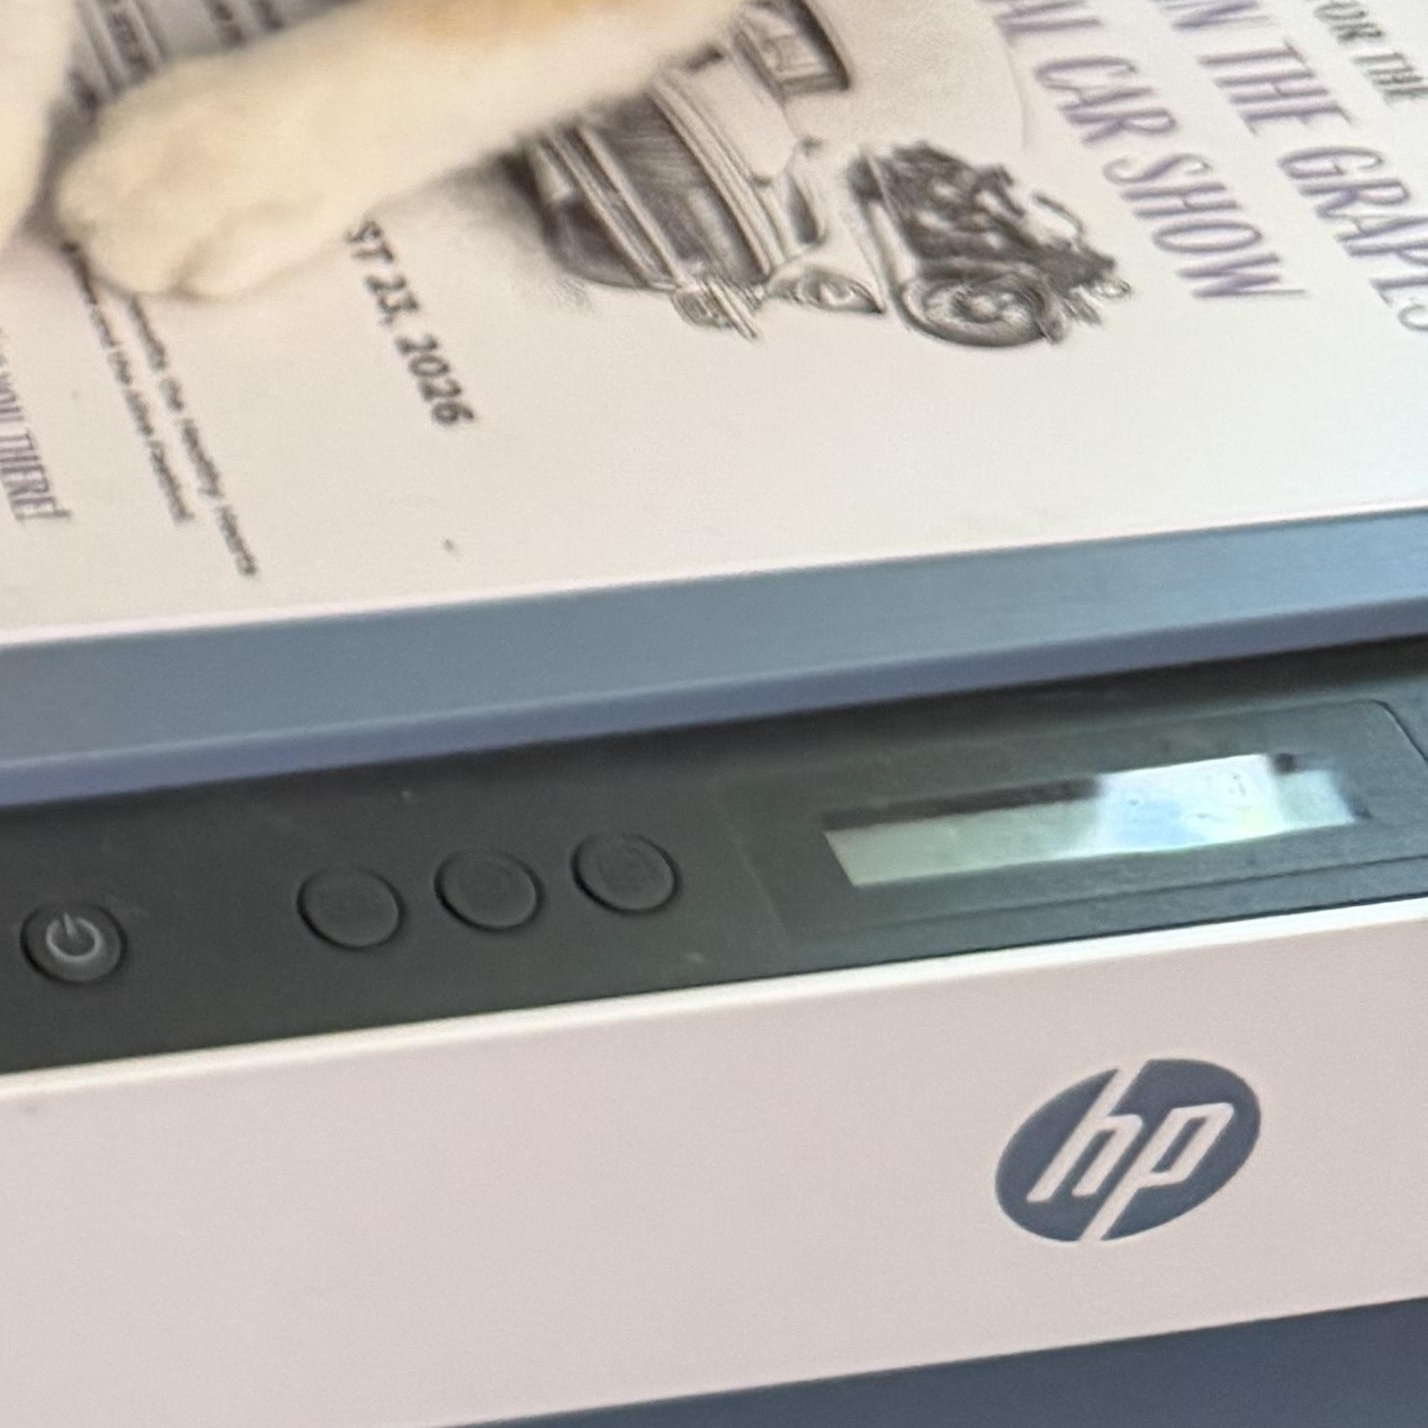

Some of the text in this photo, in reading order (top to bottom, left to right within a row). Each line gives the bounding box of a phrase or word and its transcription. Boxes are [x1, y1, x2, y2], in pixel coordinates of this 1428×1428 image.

[1033, 55, 1180, 147] CAR
[1197, 40, 1354, 136] THE
[1101, 151, 1310, 301] SHOW
[344, 219, 475, 427] ST 23, 2026
[1018, 1058, 1242, 1242] hp
